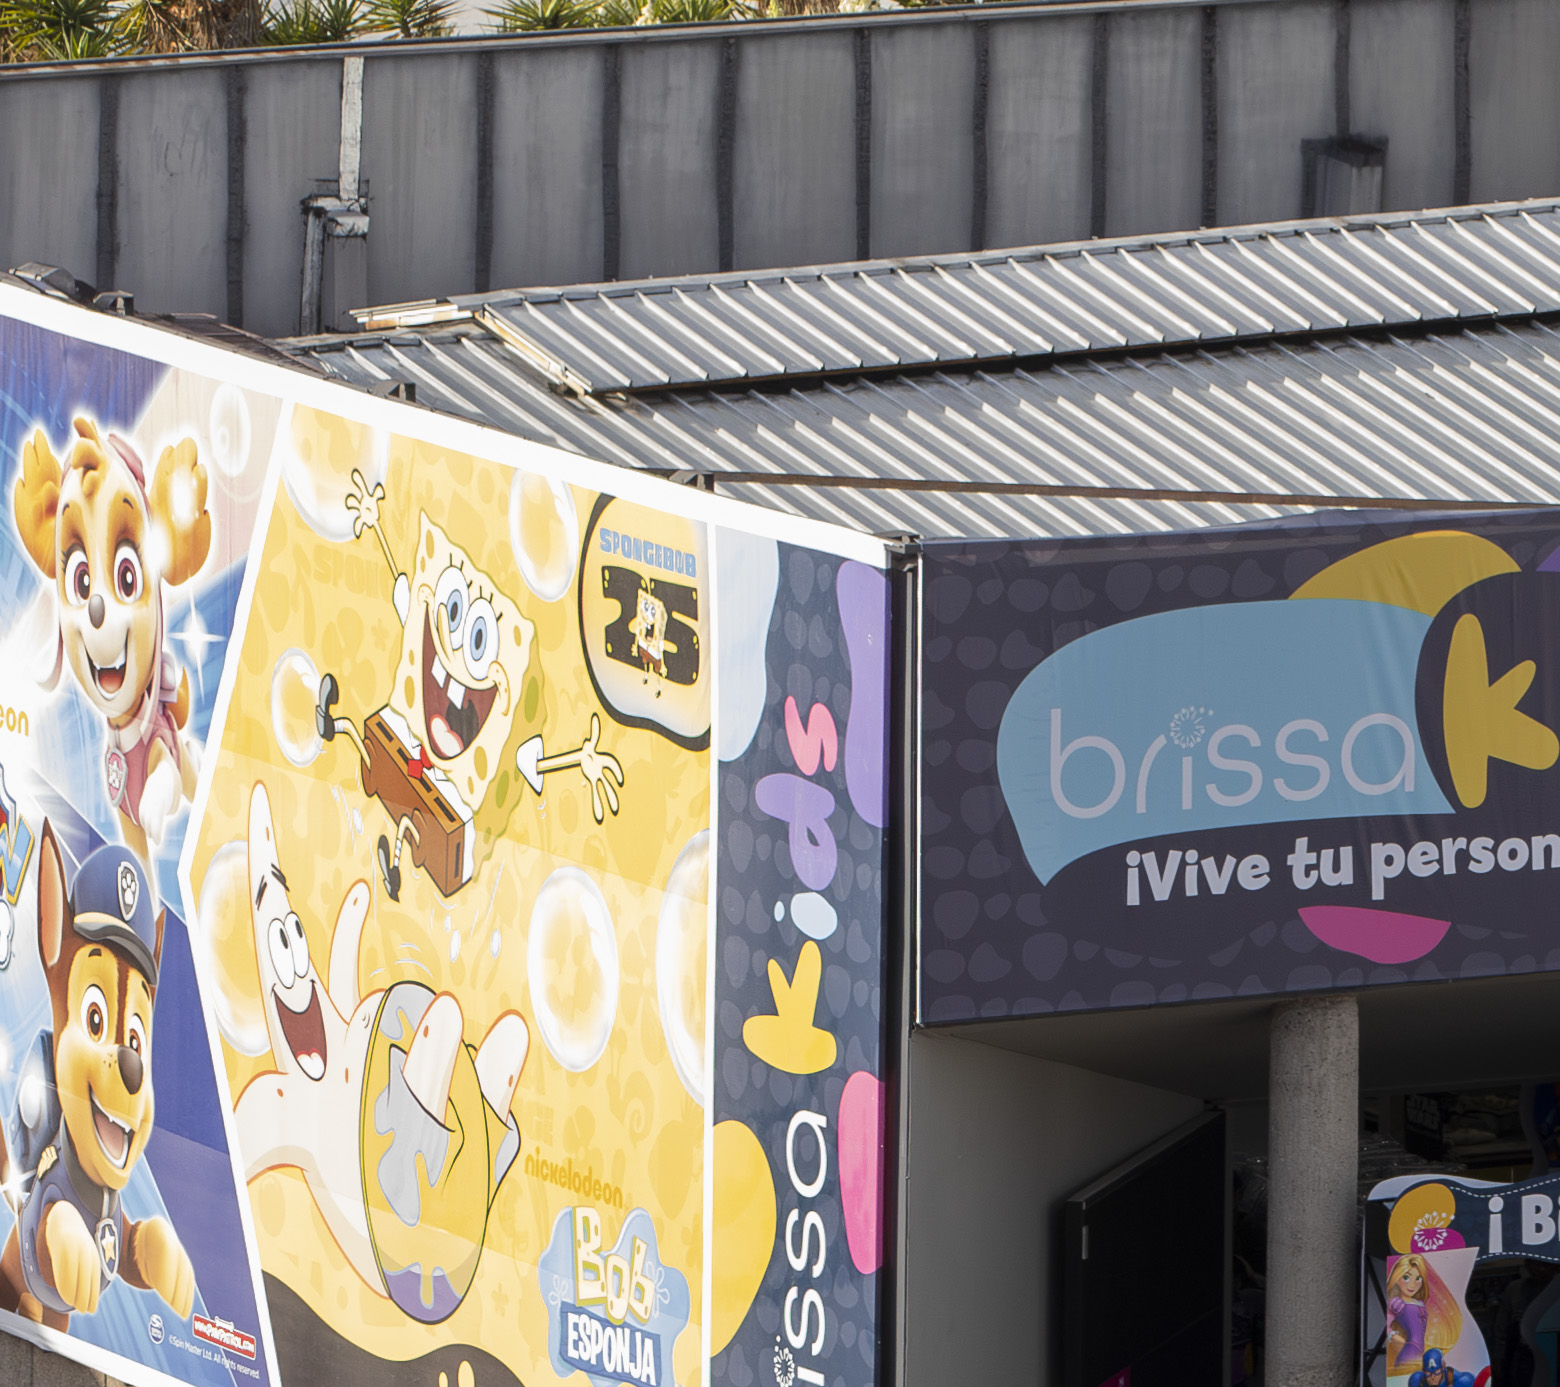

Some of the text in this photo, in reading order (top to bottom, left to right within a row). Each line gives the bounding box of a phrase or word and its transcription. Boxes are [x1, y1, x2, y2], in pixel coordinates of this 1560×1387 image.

[600, 527, 697, 577] SPONGEBOB
[1049, 705, 1417, 820] brissa
[742, 695, 839, 1073] kids
[1126, 849, 1272, 907] ¡Vive
[1286, 837, 1354, 889] tu
[525, 1153, 623, 1208] nickelodeon
[573, 1206, 656, 1325] Bob
